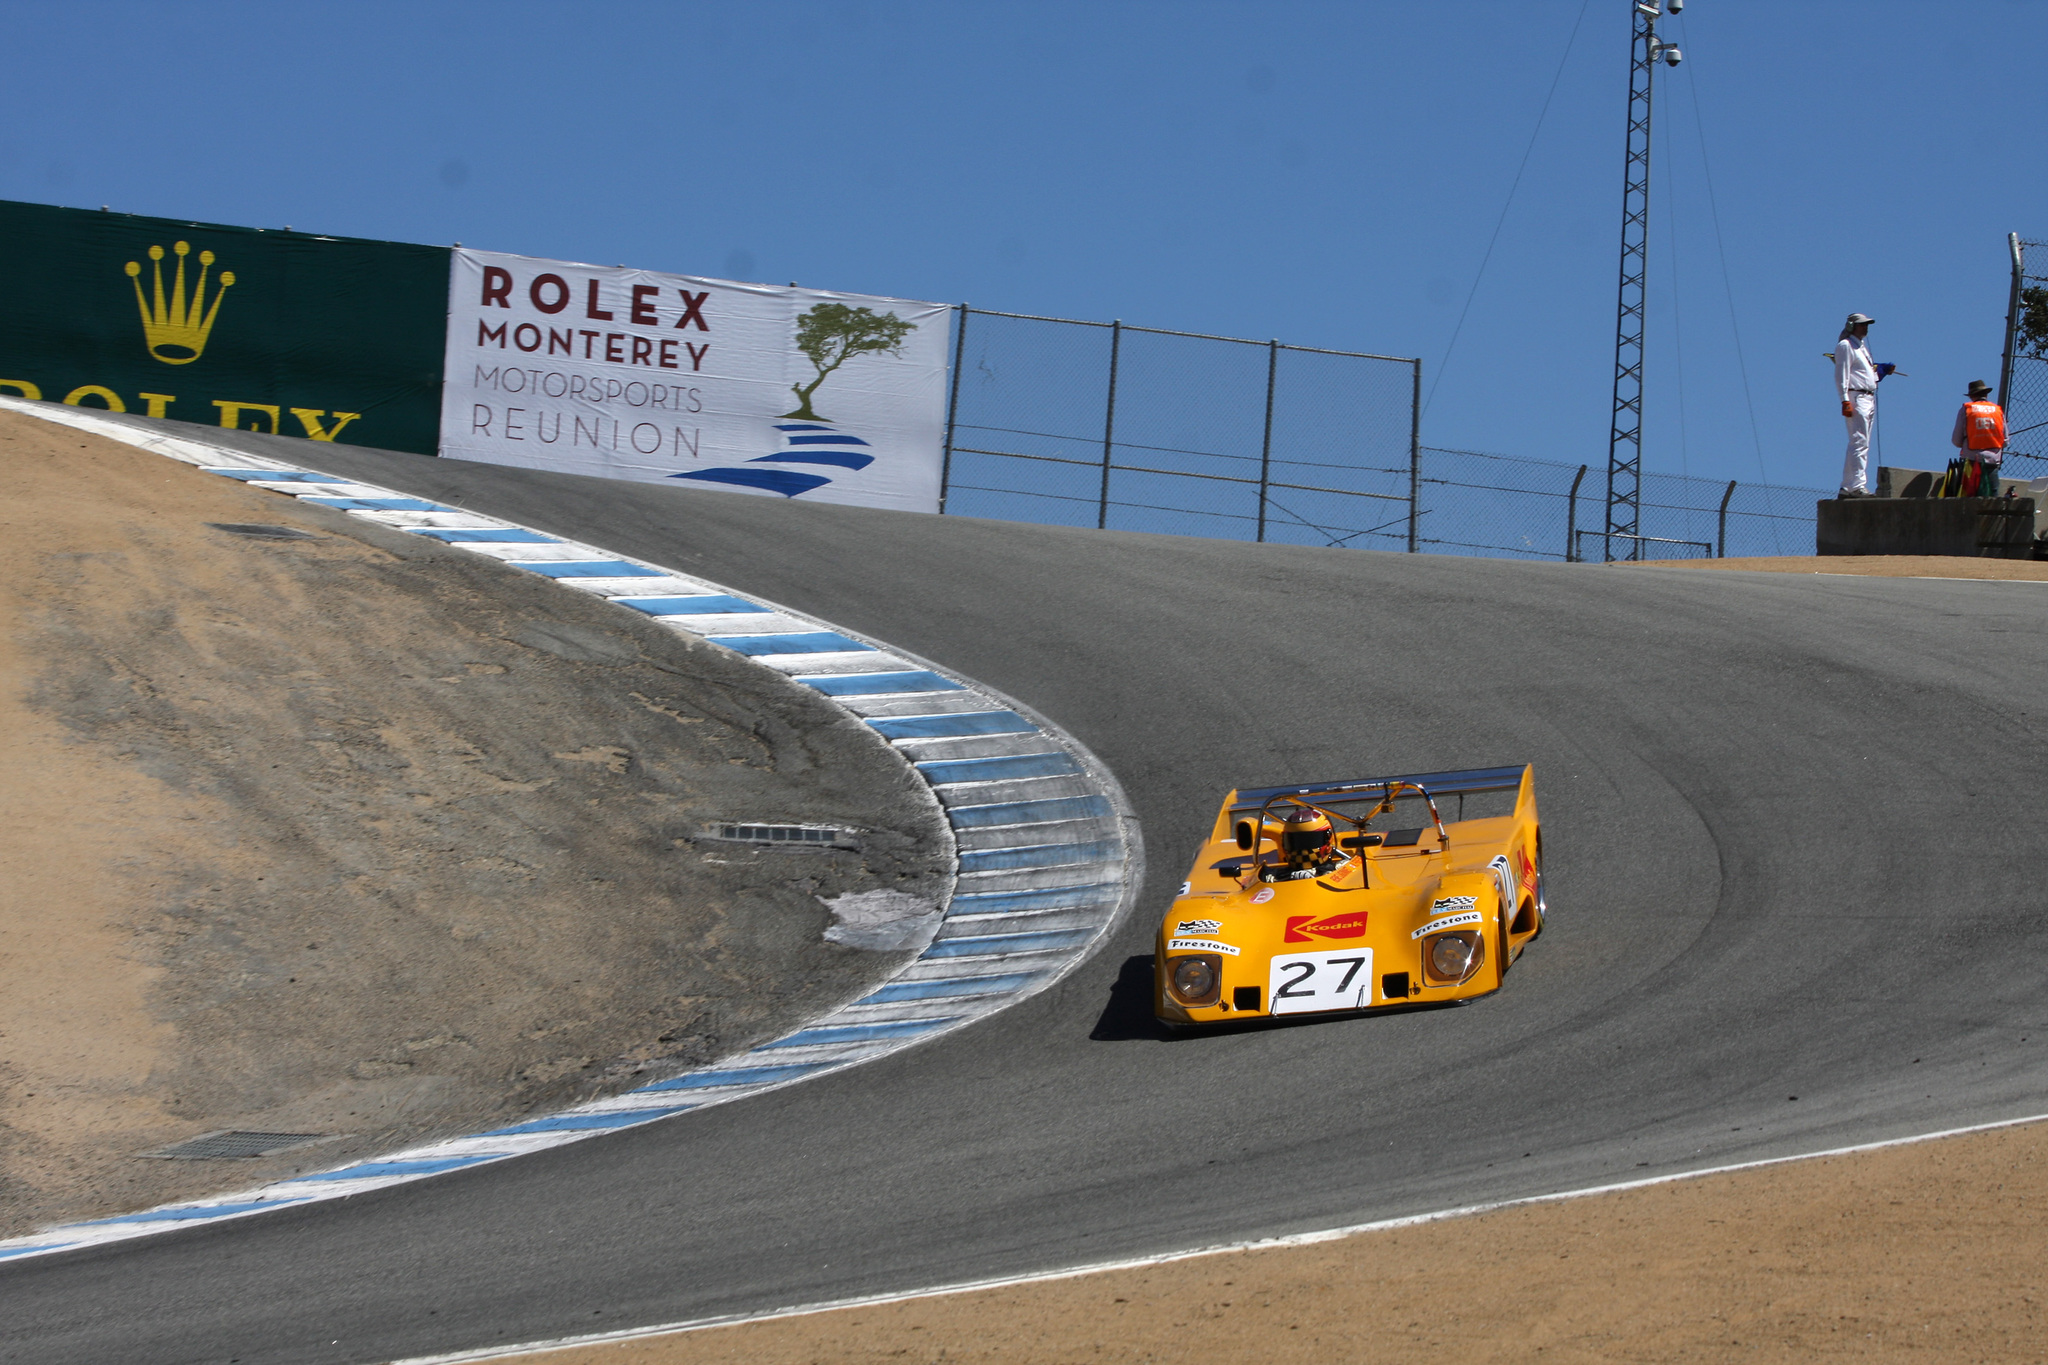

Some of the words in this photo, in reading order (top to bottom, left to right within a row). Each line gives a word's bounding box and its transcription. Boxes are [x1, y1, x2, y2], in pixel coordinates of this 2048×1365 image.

[482, 265, 711, 332] ROLEX
[478, 318, 710, 372] MONTEREY
[474, 364, 702, 413] MOTORSPORTS
[472, 403, 700, 458] REUNION
[1171, 940, 1237, 953] Firestone
[1306, 921, 1363, 932] Kodak
[1414, 913, 1479, 937] Firestone
[1277, 956, 1366, 999] 27
